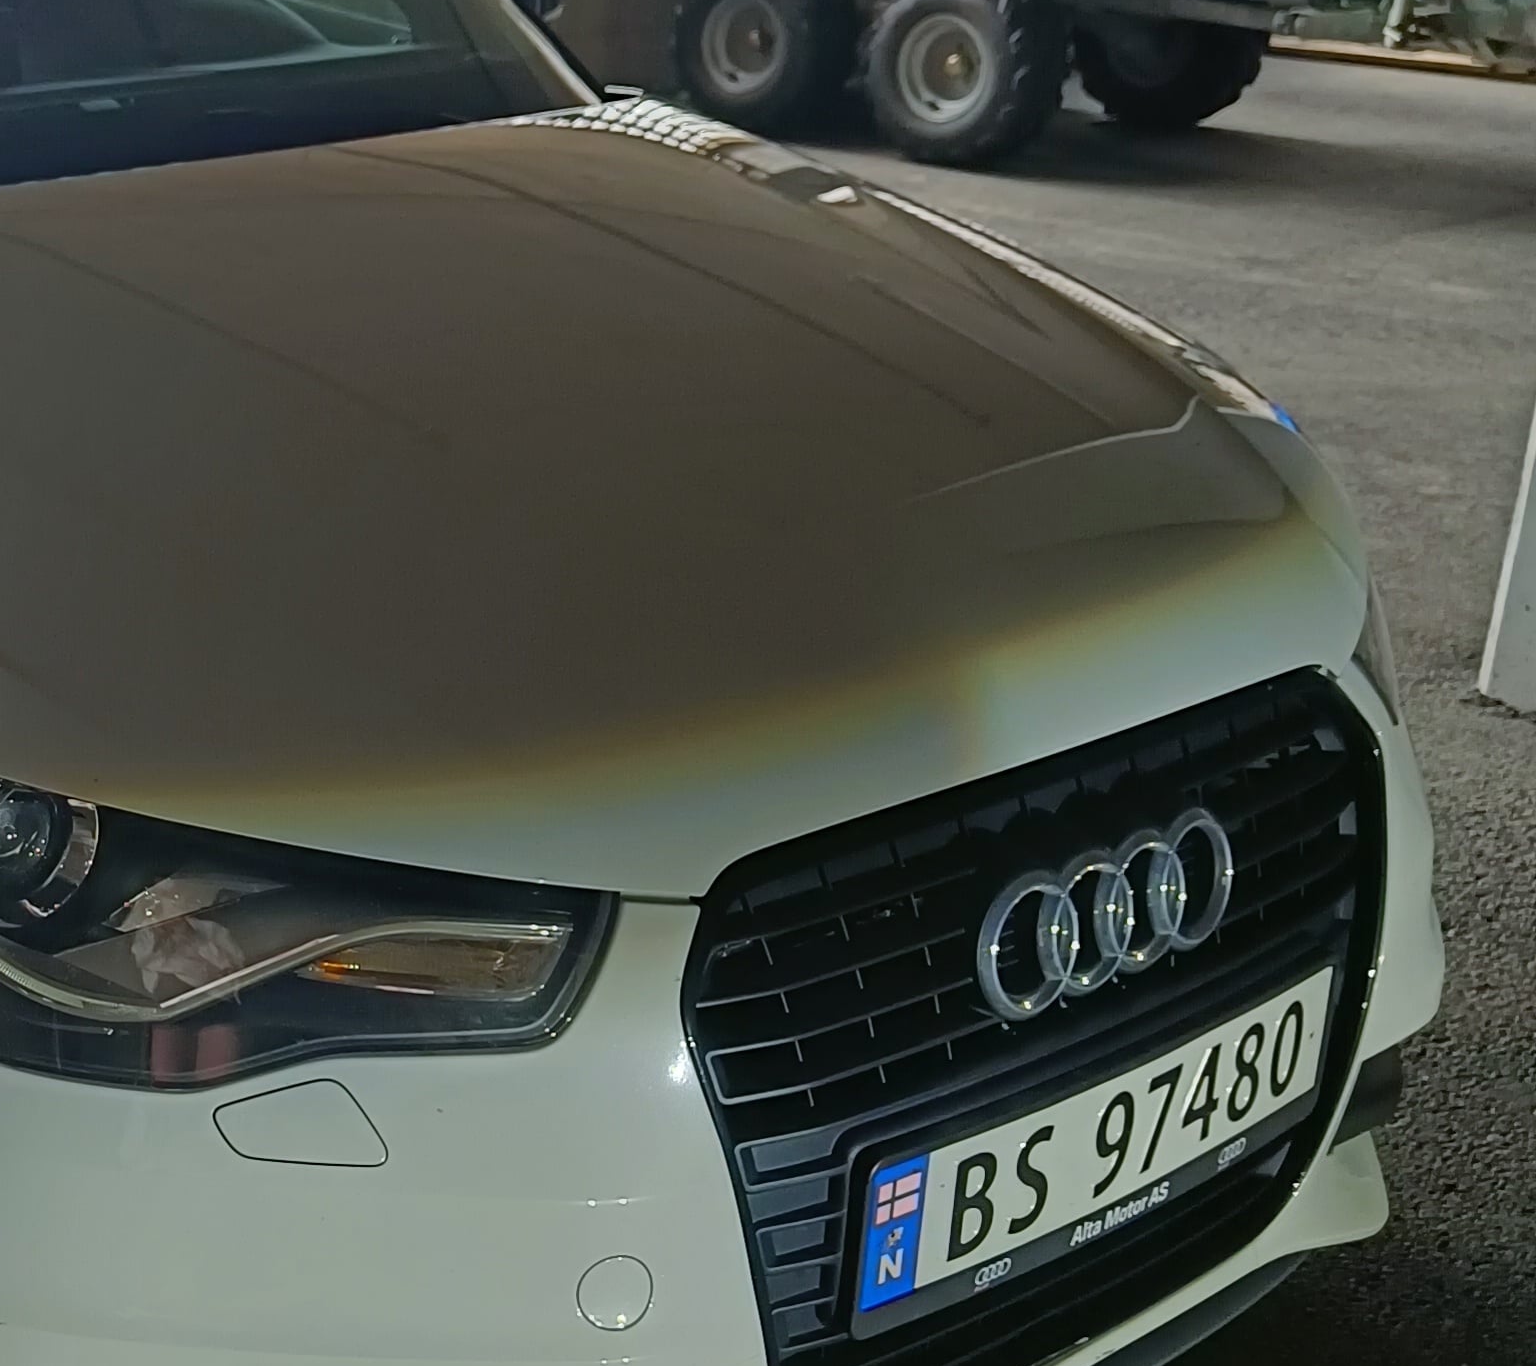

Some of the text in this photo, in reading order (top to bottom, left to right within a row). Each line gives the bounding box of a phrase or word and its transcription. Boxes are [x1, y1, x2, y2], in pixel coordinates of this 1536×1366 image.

[947, 1000, 1304, 1262] BS 97480
[1070, 1181, 1170, 1247] Alta Motor AS
[877, 1247, 904, 1285] N
